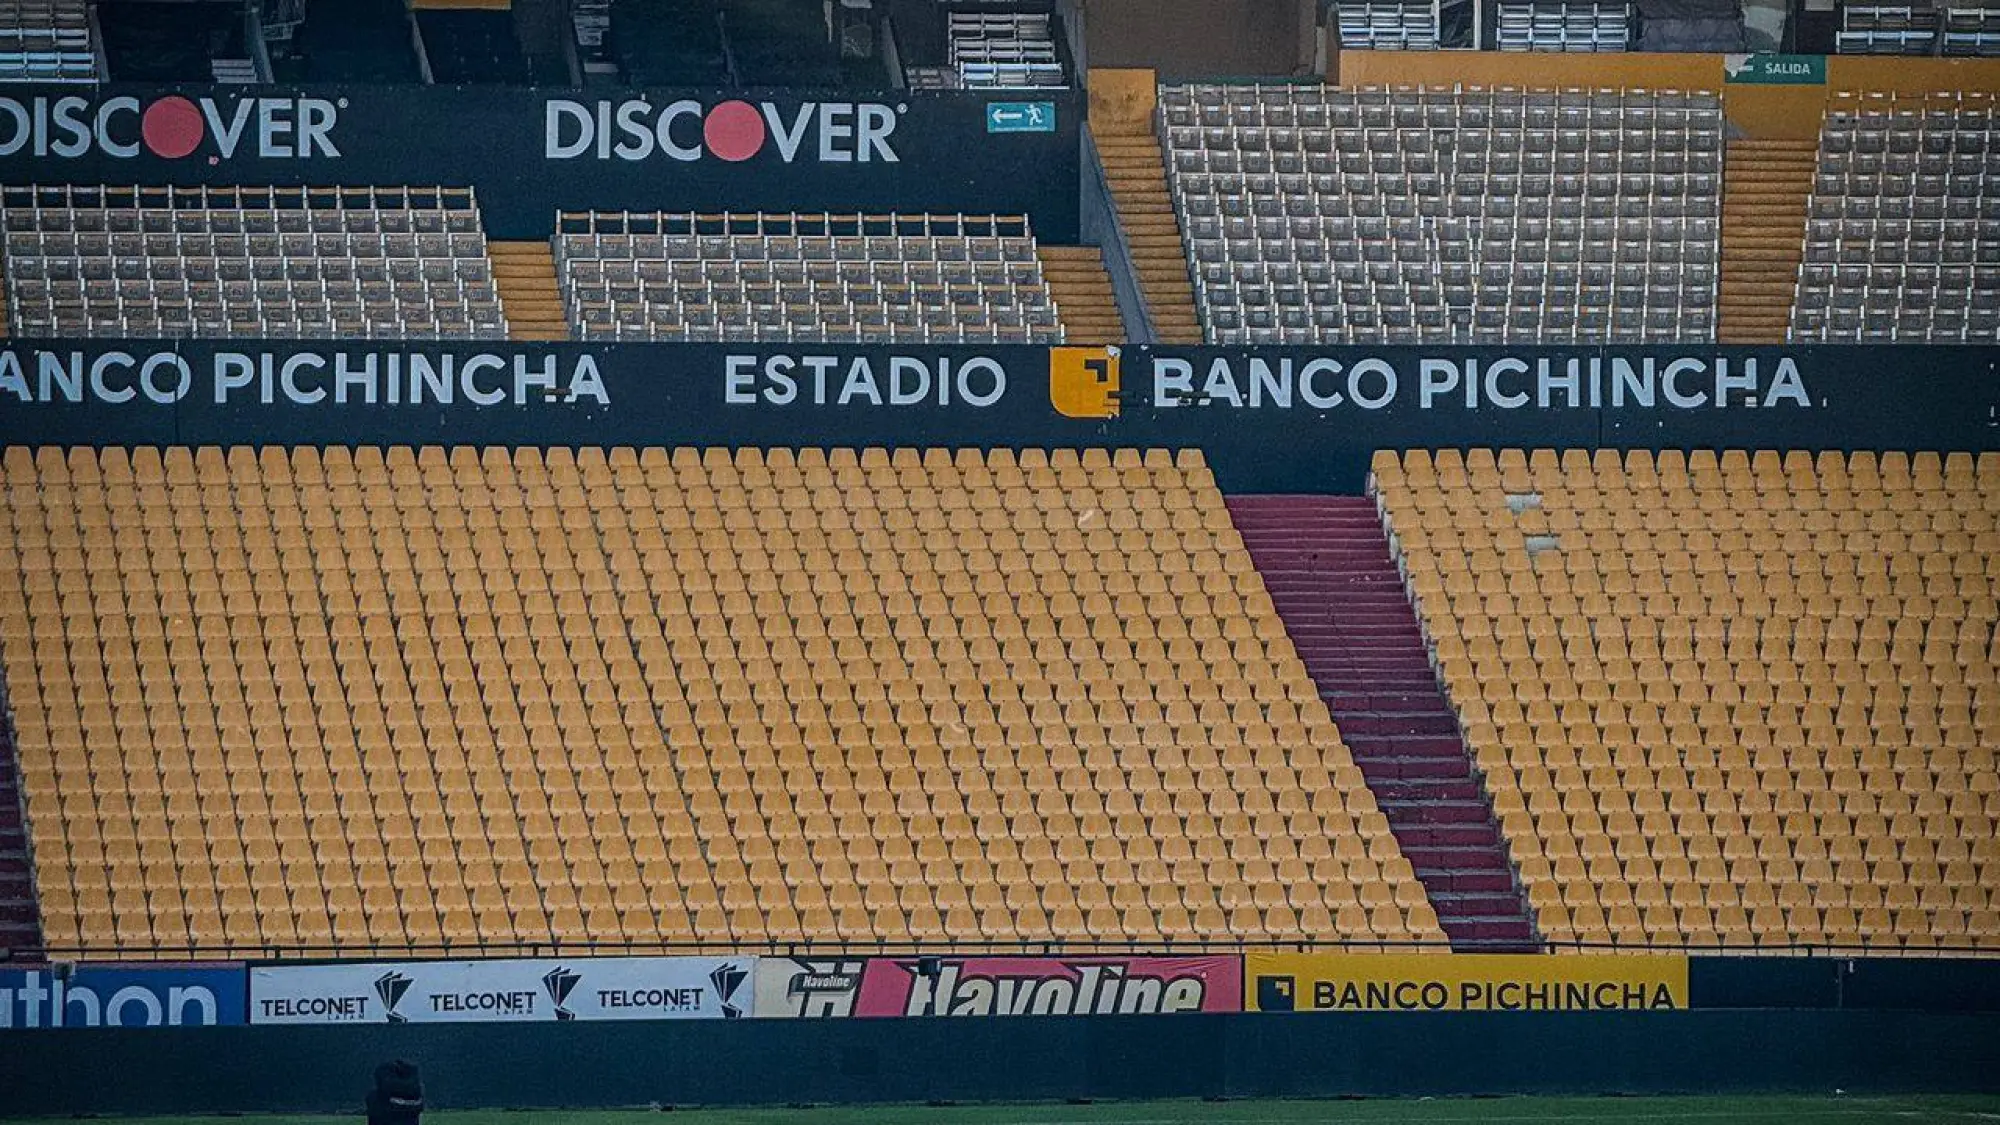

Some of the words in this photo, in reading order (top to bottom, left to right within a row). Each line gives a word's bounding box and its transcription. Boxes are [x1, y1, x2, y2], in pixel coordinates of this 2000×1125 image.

[1765, 62, 1811, 75] SALIDA
[545, 99, 899, 162] DISCOVER
[214, 352, 610, 406] PICHINCHA
[725, 355, 1007, 408] ESTADIO
[1153, 357, 1398, 409] BANCO
[1420, 357, 1811, 409] PICHINCHA
[803, 975, 851, 987] Havoline
[907, 962, 1205, 1017] Havoline
[261, 996, 369, 1017] TELCONET
[430, 991, 537, 1012] TELCONET
[597, 988, 704, 1007] TELCONET
[1313, 980, 1449, 1010] BANCO
[1460, 981, 1675, 1010] PICHINCHA
